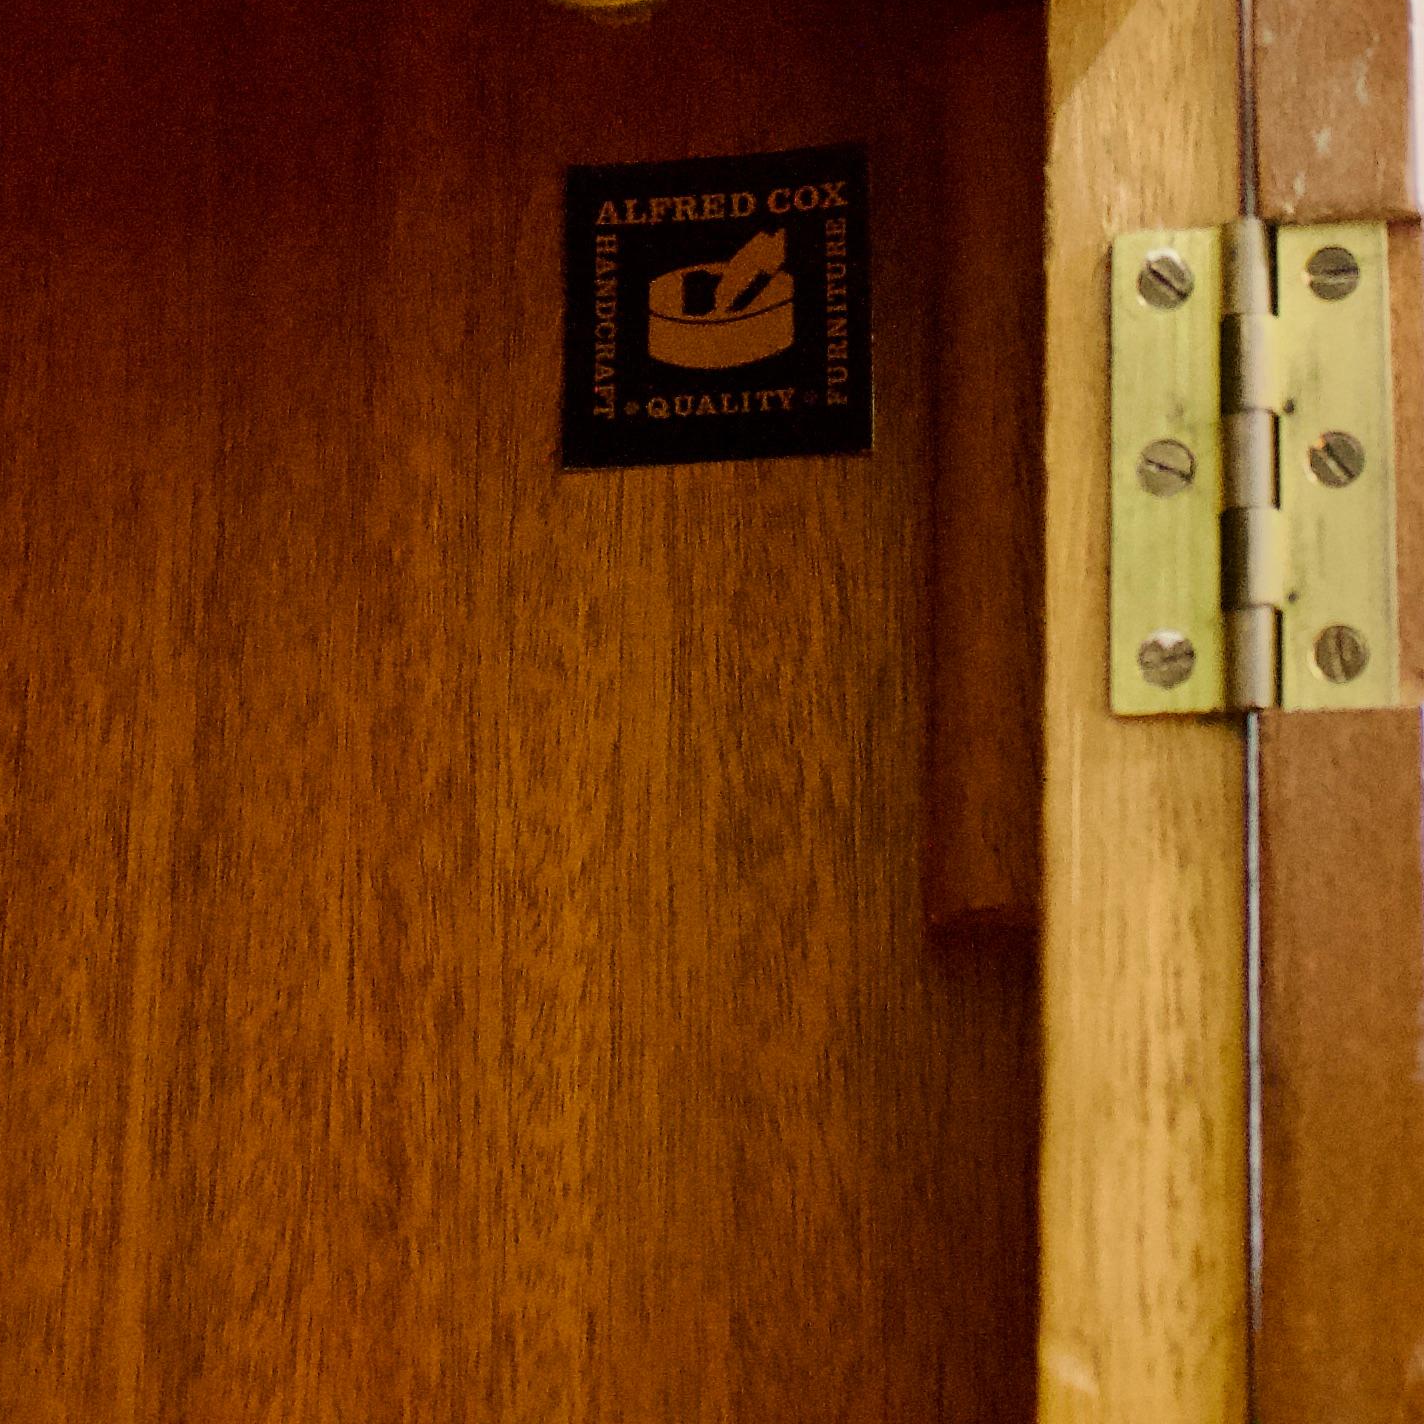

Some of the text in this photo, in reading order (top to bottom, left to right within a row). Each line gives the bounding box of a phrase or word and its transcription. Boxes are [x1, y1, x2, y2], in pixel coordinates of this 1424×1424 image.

[596, 181, 849, 225] ALFRED COX
[593, 232, 618, 420] HANDCRAFT
[825, 217, 849, 406] FURNITURE
[647, 388, 796, 420] QUALITY
